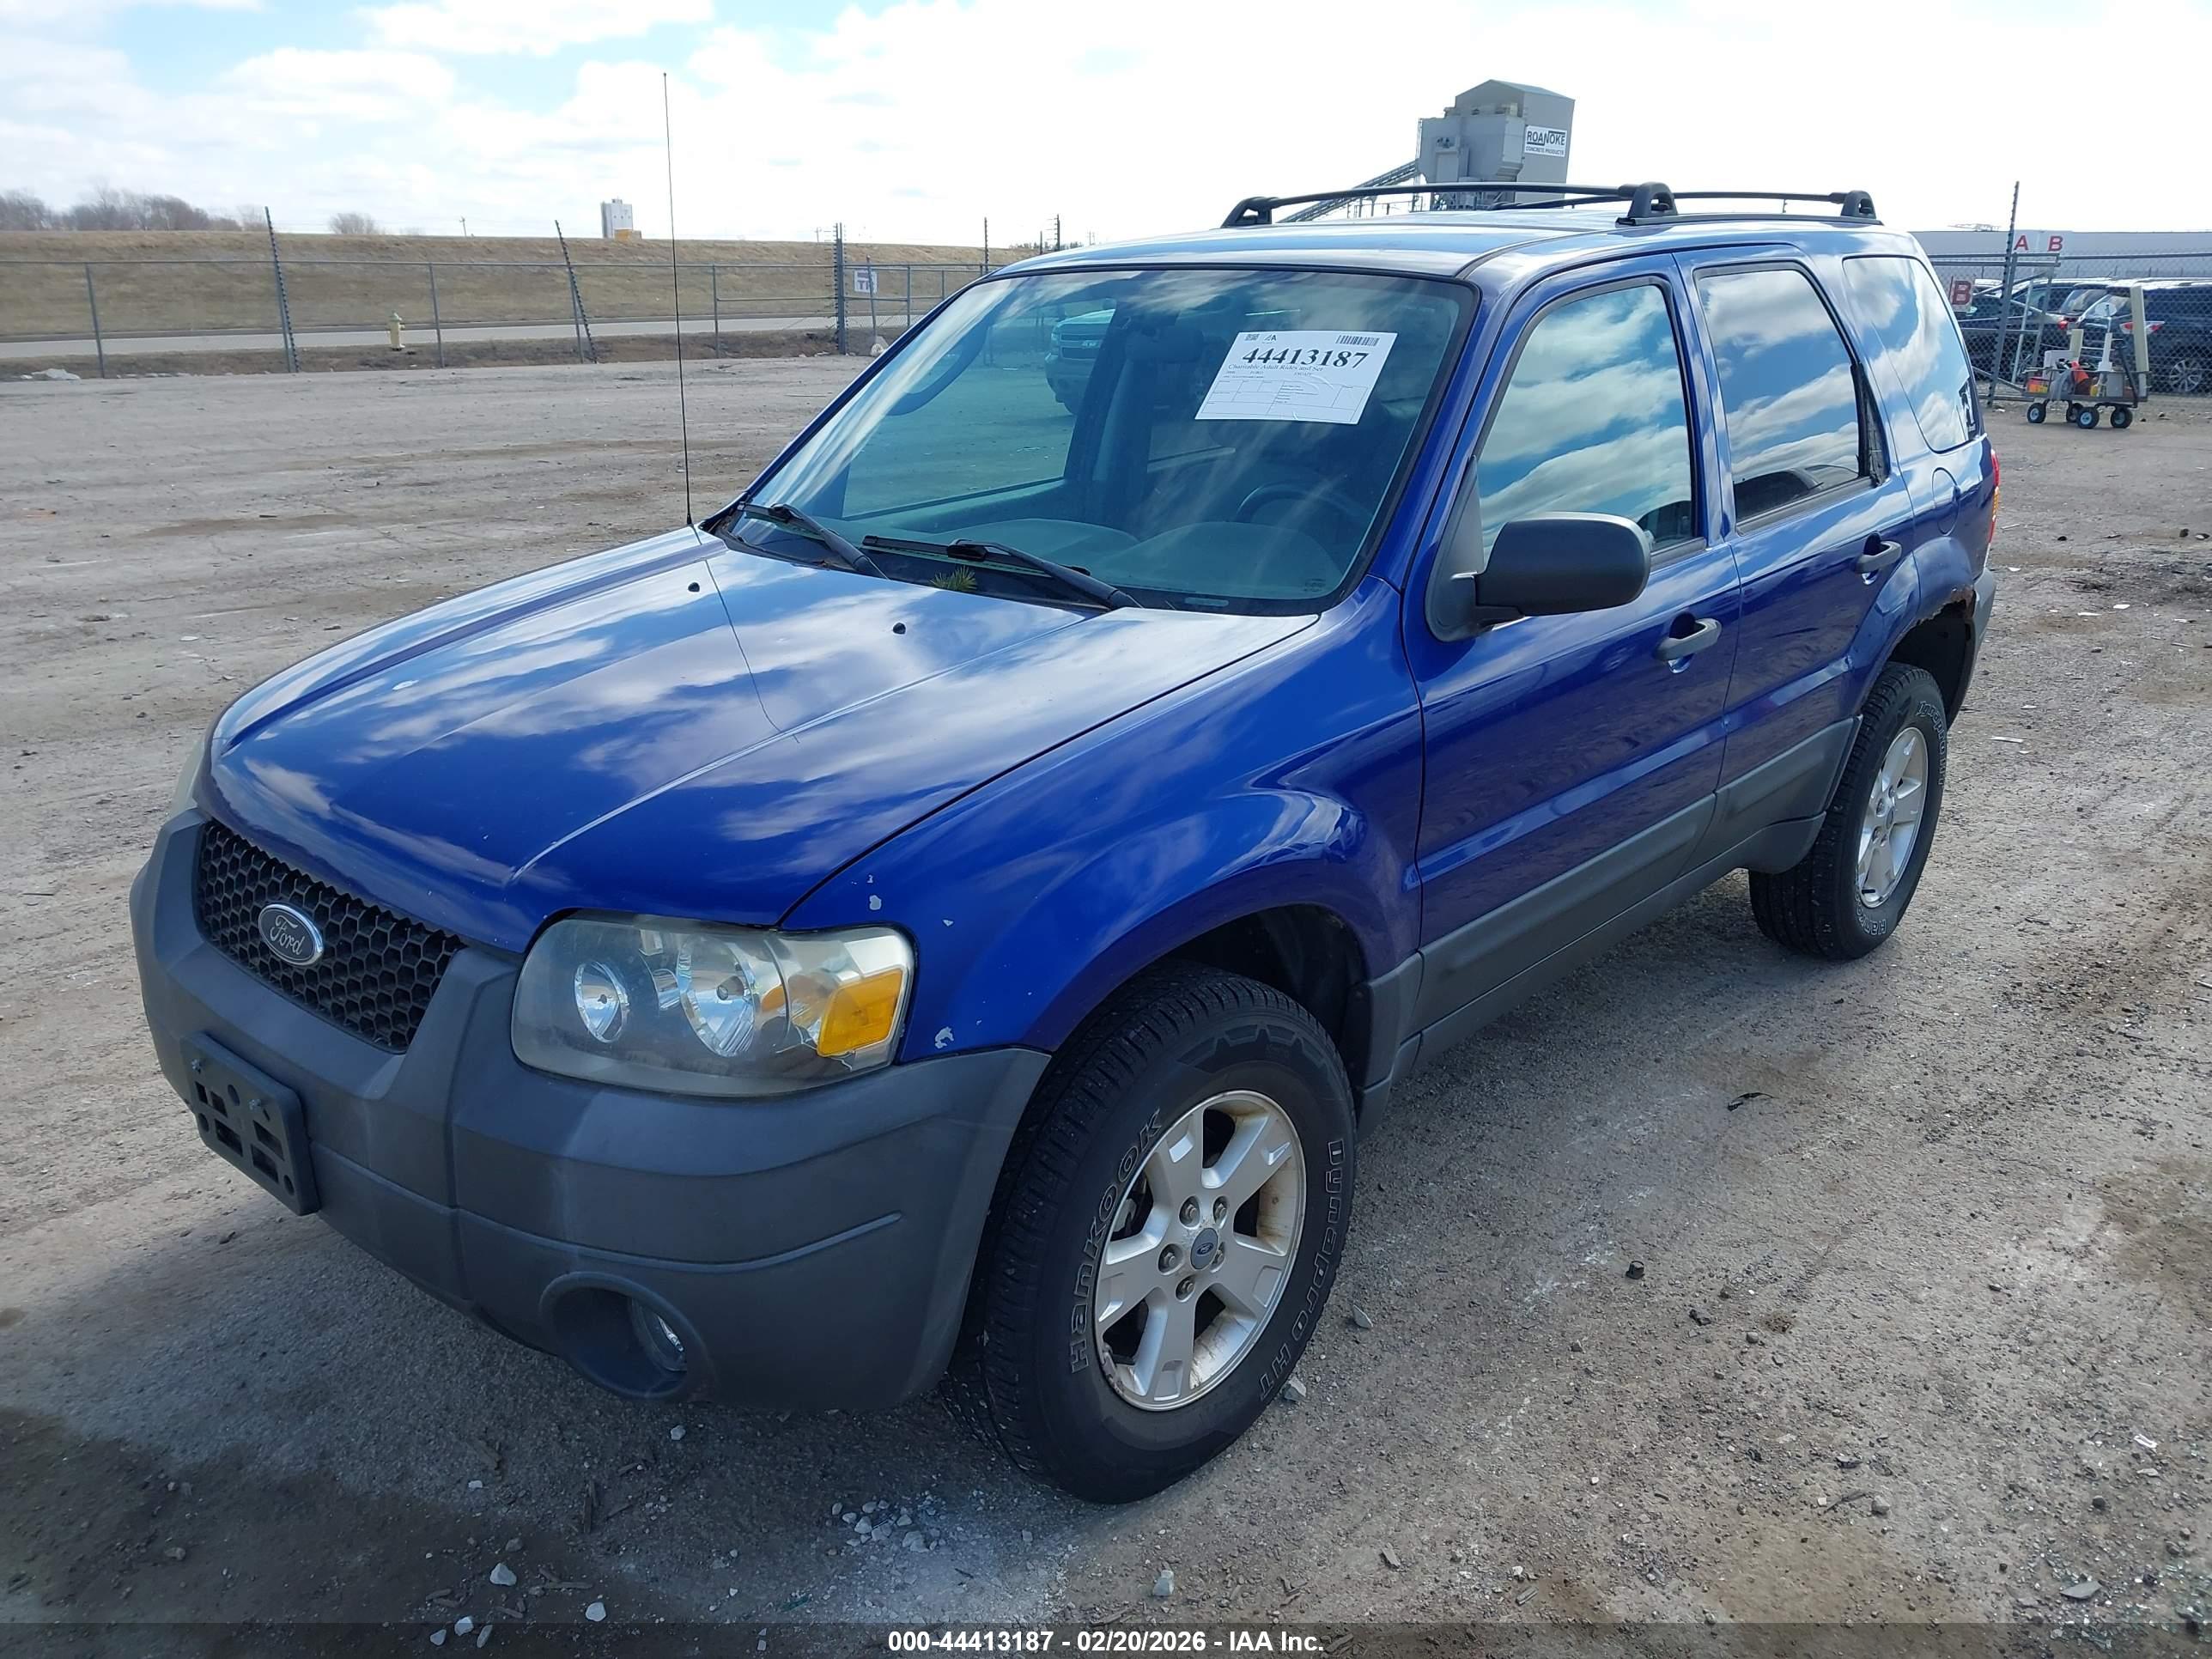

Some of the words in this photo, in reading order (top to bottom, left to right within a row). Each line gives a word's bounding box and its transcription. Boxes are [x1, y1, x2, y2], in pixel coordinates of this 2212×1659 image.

[1527, 131, 1565, 145] ROANOKE
[2014, 235, 2028, 250] A
[2048, 235, 2063, 251] B
[1951, 280, 1972, 305] B
[1243, 348, 1370, 369] 44413187
[270, 915, 306, 955] Ford
